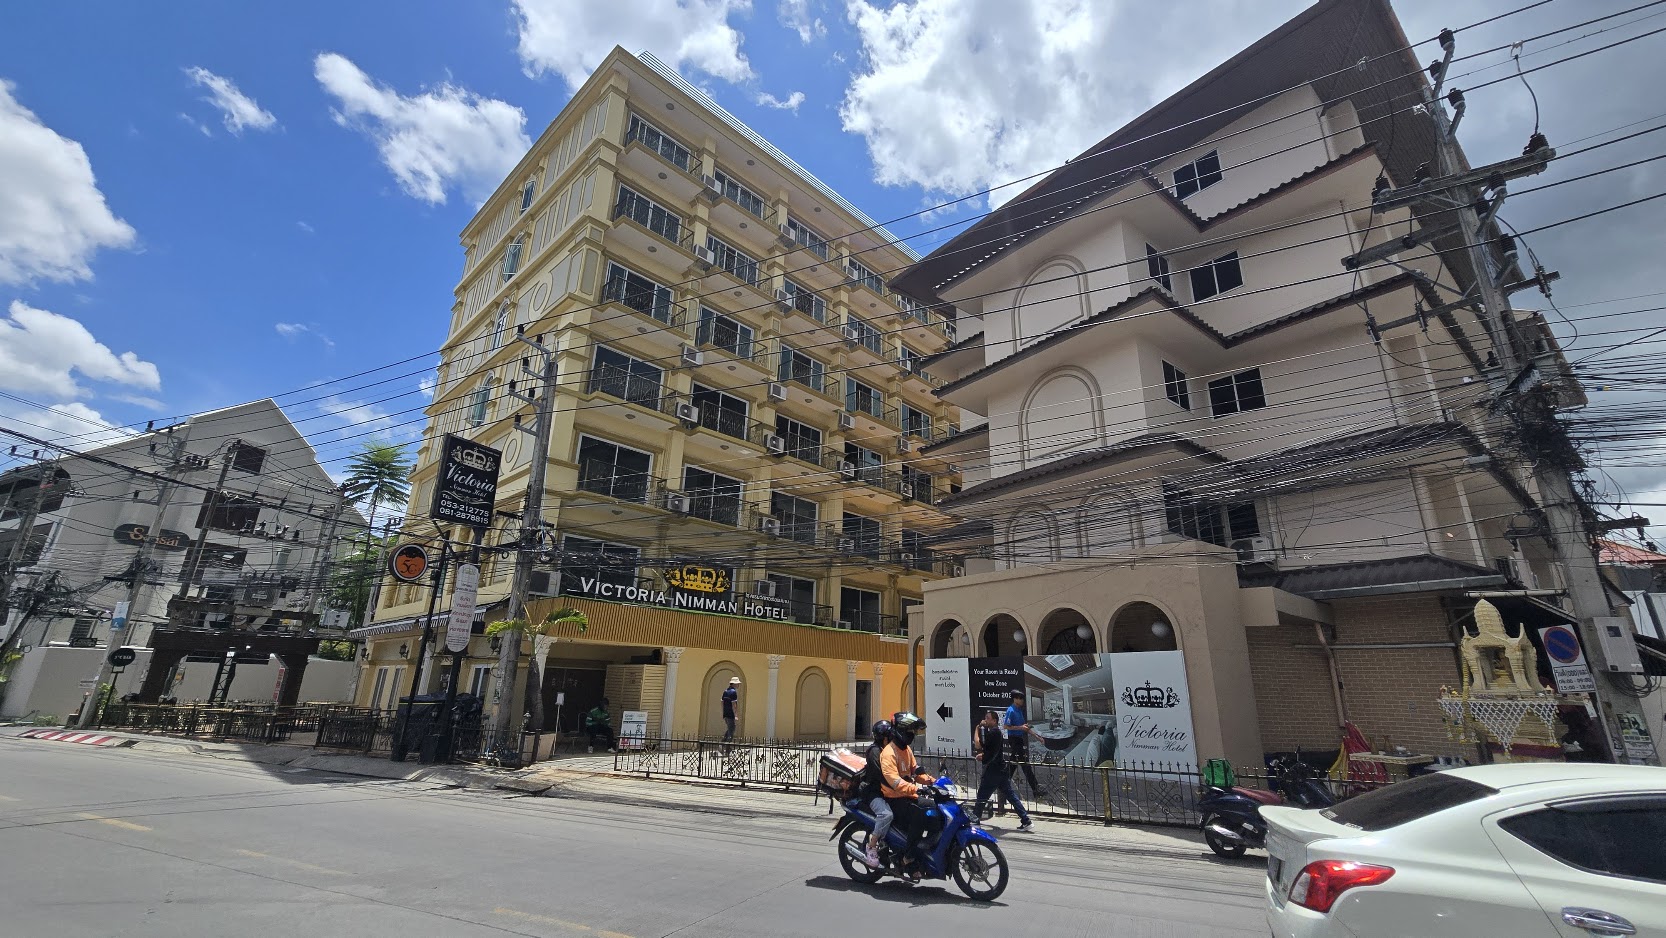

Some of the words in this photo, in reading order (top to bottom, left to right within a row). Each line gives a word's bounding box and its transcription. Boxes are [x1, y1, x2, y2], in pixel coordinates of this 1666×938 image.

[447, 462, 495, 492] Victoria
[1004, 668, 1019, 676] Ready
[1122, 714, 1187, 741] Victoria
[937, 735, 956, 743] Entrance
[1125, 738, 1159, 750] Nimman
[1162, 740, 1188, 752] Hotel
